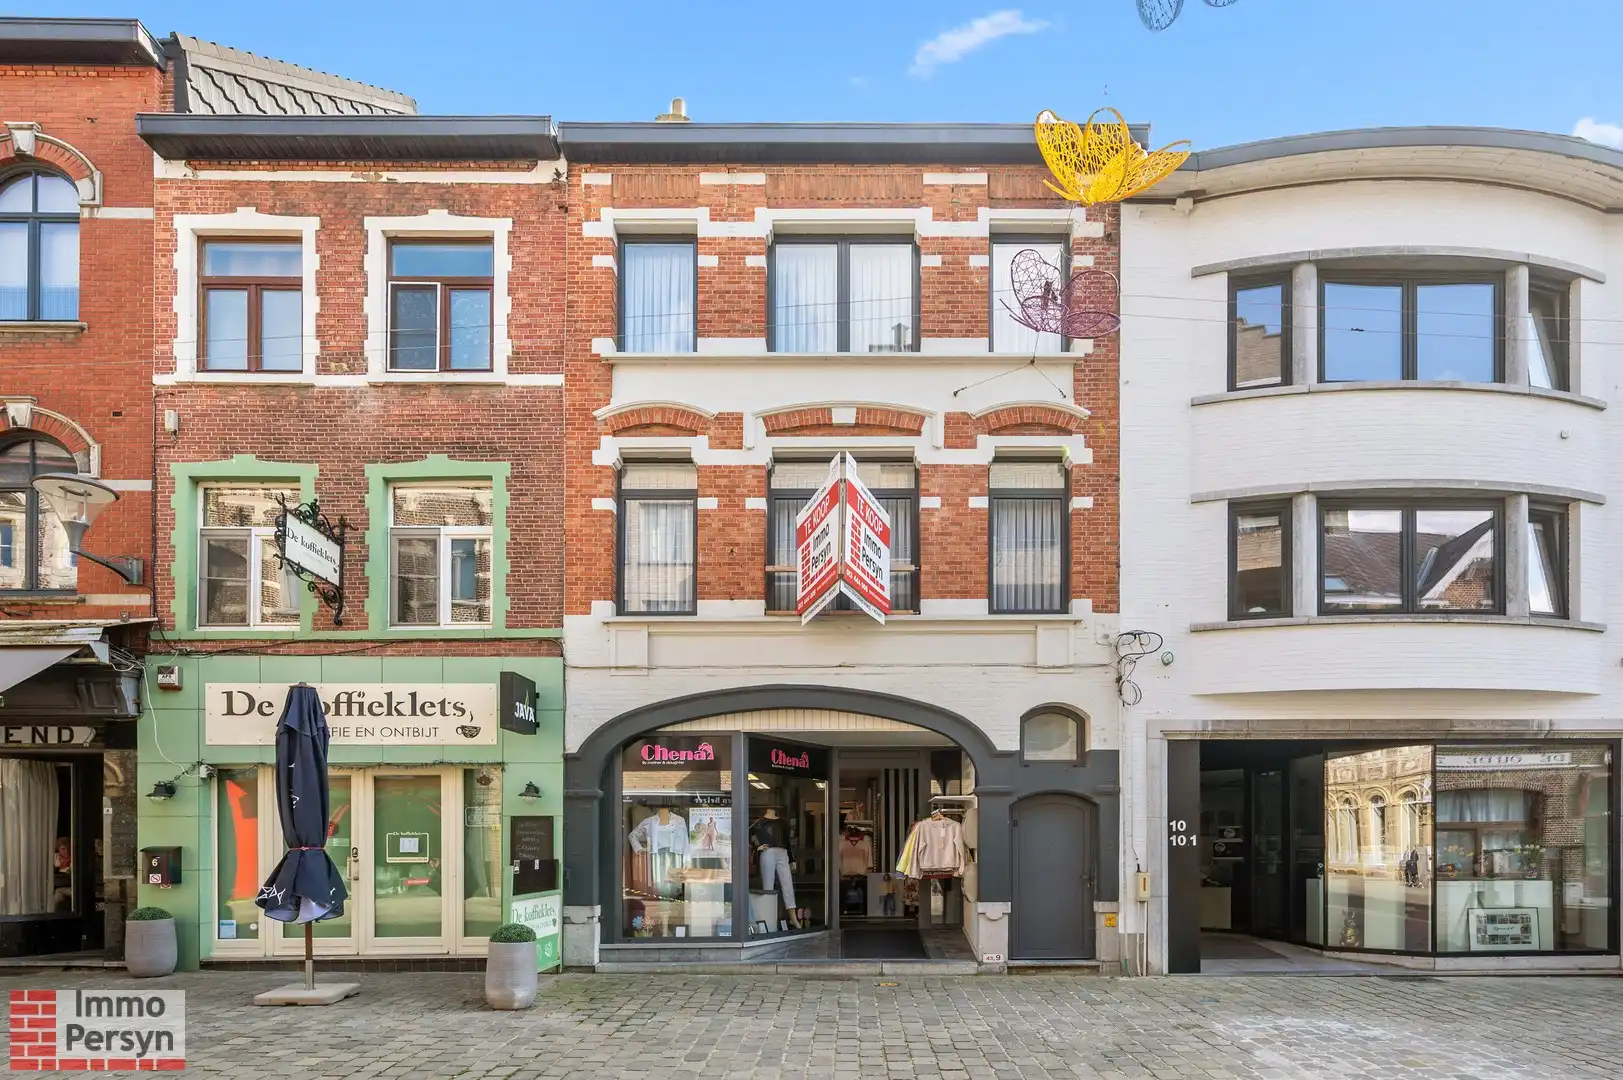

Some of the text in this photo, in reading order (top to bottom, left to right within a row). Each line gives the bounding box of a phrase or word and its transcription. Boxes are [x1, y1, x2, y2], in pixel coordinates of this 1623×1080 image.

[812, 494, 830, 529] KOOP
[857, 492, 865, 517] TE
[865, 504, 883, 536] KOOP
[287, 527, 337, 565] De koffieklets
[812, 523, 830, 552] Immo
[863, 527, 882, 559] Immo
[811, 541, 832, 573] Persyn
[861, 545, 884, 580] Persyn
[221, 690, 467, 717] De offieklets
[514, 701, 535, 723] JAVA
[355, 726, 375, 738] EN
[379, 726, 440, 739] ONTBIJT
[1169, 820, 1187, 832] 10
[1169, 834, 1197, 846] 10.1
[151, 858, 159, 867] 6
